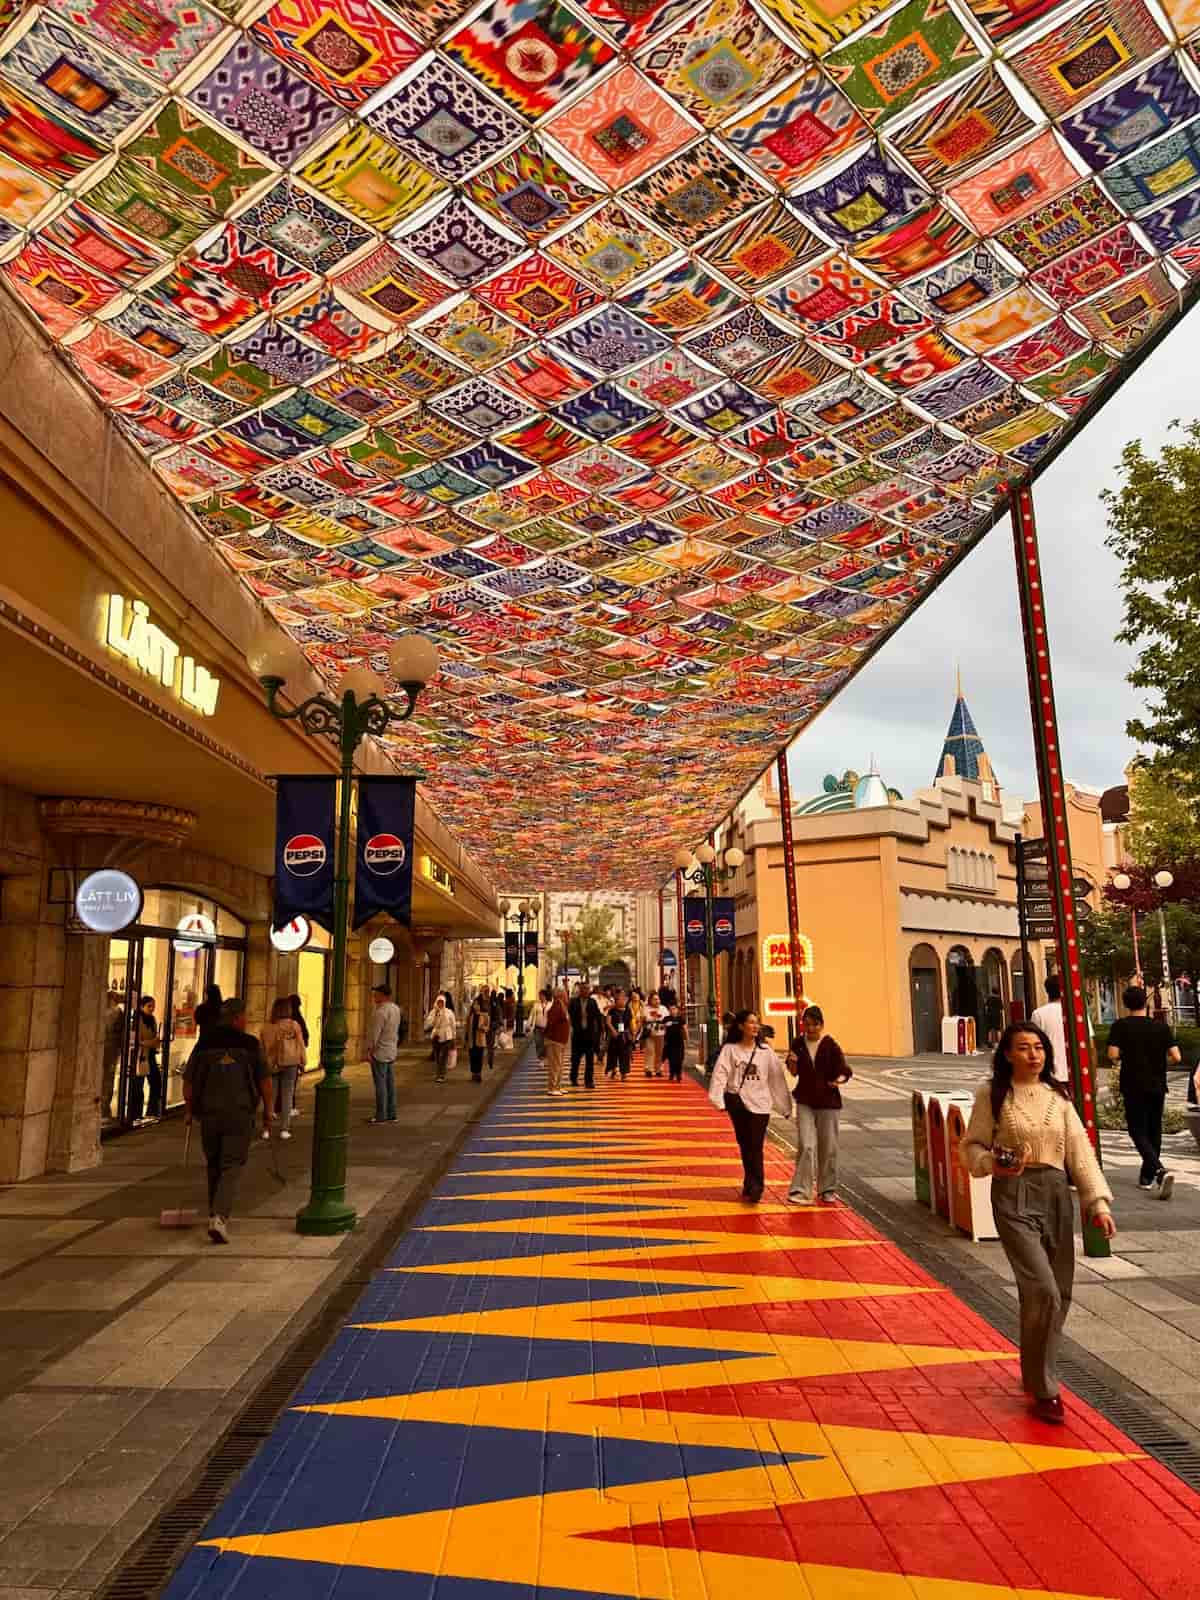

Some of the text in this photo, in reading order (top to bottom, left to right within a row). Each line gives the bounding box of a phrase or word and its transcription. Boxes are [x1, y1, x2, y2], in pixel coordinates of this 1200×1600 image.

[286, 850, 325, 860] PEPSI
[366, 849, 403, 859] PEPSI
[116, 890, 137, 903] LIV
